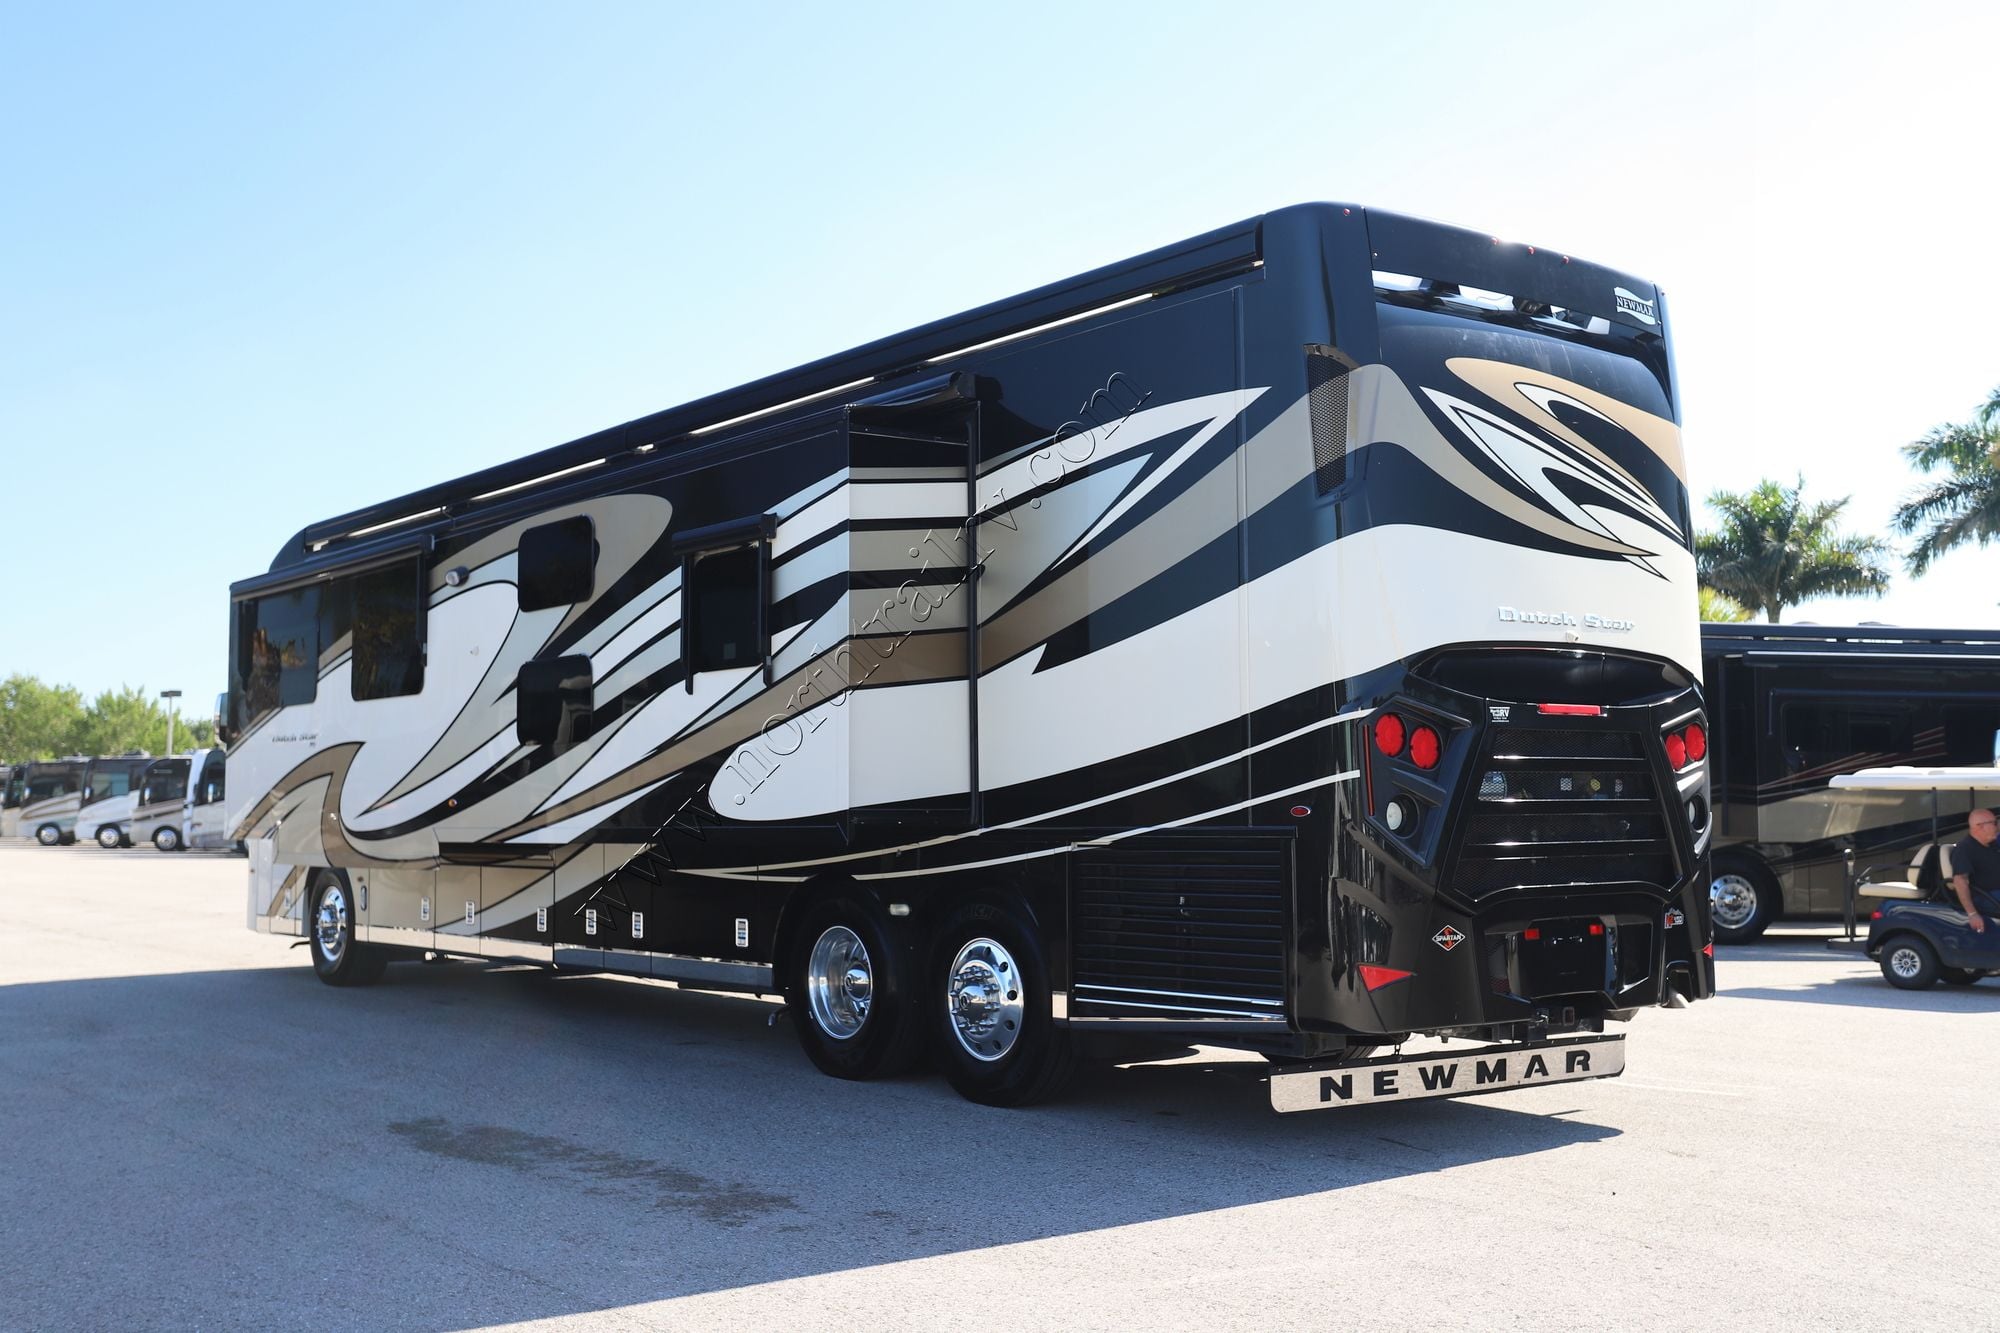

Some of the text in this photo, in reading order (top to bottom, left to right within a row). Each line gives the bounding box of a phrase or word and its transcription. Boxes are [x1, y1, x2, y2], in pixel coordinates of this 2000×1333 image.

[1616, 295, 1654, 317] NEWMAR
[1498, 606, 1634, 631] Dutch Star
[1435, 934, 1462, 943] SPARTAN
[1320, 1050, 1591, 1103] NEWMAR
